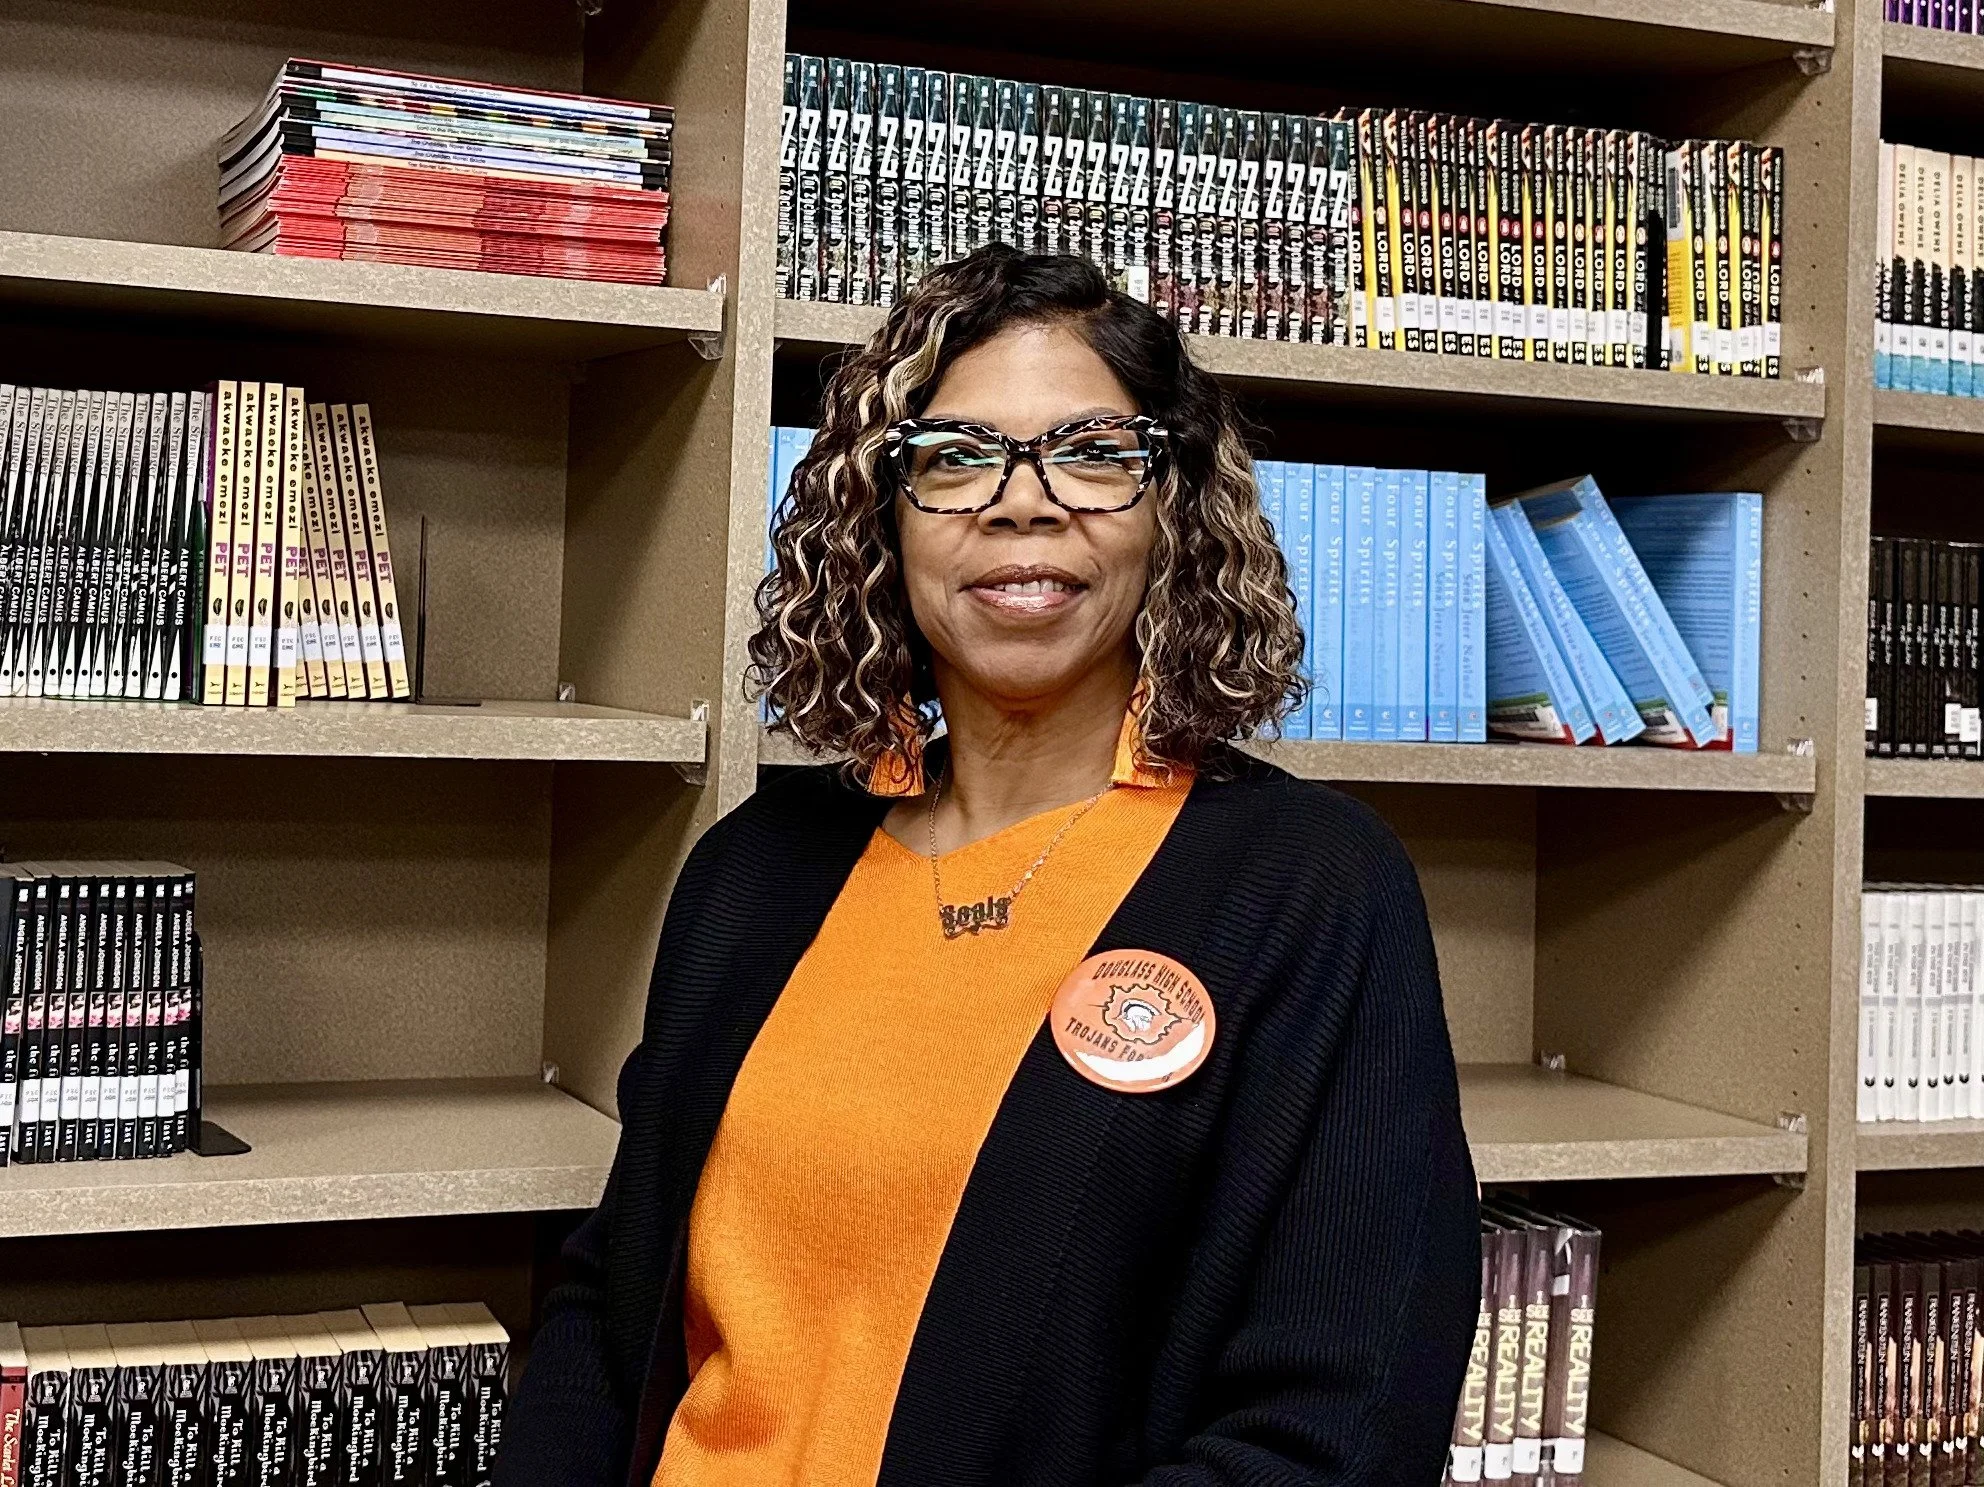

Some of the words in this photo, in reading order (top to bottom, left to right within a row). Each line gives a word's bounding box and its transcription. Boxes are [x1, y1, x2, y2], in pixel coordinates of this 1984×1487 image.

[801, 108, 821, 171] Z
[828, 109, 848, 171] Z
[880, 116, 899, 179] Z
[1403, 233, 1415, 276] LORD
[1421, 235, 1432, 278] LORD
[1442, 237, 1453, 280] LORD
[1459, 239, 1470, 282] LORD
[1478, 241, 1488, 284] LORD
[1534, 245, 1545, 288] LORD
[1556, 245, 1566, 288] LORD
[32, 396, 43, 417] The
[61, 398, 73, 419] The
[91, 400, 102, 421] The
[154, 401, 164, 422] The
[173, 402, 184, 423] The
[222, 391, 232, 467] akwaeke
[244, 393, 255, 468] akwaeke
[267, 393, 279, 467] akwaeke
[290, 398, 300, 472] akwaeke
[26, 422, 40, 475] Stranger
[55, 424, 70, 477] Stranger
[86, 425, 100, 477] Stranger
[150, 427, 163, 479] Stranger
[169, 427, 182, 478] Stranger
[316, 412, 331, 481] akwaeke
[333, 549, 347, 581] PET
[337, 414, 353, 482] akwaeke
[355, 550, 369, 581] PET
[359, 416, 375, 484] akwaeke
[377, 551, 392, 583] PET
[1331, 481, 1343, 525] Four
[1361, 482, 1373, 525] Four
[1387, 484, 1399, 528] Four
[1415, 485, 1426, 528] Four
[13, 545, 25, 583] ALBERT
[43, 546, 55, 584] ALBERT
[75, 546, 86, 584] ALBERT
[140, 548, 150, 586] ALBERT
[159, 549, 170, 587] ALBERT
[214, 542, 227, 577] PET
[236, 543, 250, 578] PET
[260, 542, 273, 577] PET
[285, 547, 298, 580] PET
[314, 548, 329, 579] PET
[1328, 536, 1342, 604] Spirits
[1358, 536, 1373, 604] Spirits
[1384, 539, 1399, 607] Spirits
[1411, 539, 1425, 607] Spirits
[9, 586, 20, 622] CAMUS
[39, 587, 50, 622] CAMUS
[71, 587, 82, 622] CAMUS
[136, 589, 147, 624] CAMUS
[156, 590, 167, 626] CAMUS
[1092, 960, 1156, 980] DOUGLASS
[1154, 965, 1181, 993] HIGH
[91, 1043, 101, 1061] the
[128, 1043, 138, 1061] the
[148, 1042, 158, 1060] the
[1065, 1017, 1118, 1052] TROJANS
[29, 1045, 40, 1064] the
[25, 1126, 36, 1147] last
[85, 1123, 96, 1144] last
[124, 1122, 134, 1143] last
[144, 1122, 154, 1142] last
[1463, 1329, 1490, 1439] REALITY
[1494, 1326, 1520, 1436] REALITY
[1521, 1321, 1548, 1431] REALITY
[1566, 1325, 1593, 1435] REALITY
[5, 1408, 20, 1433] The
[322, 1413, 333, 1430] To
[365, 1409, 375, 1426] To
[410, 1408, 420, 1424] To
[451, 1403, 461, 1420] To
[491, 1399, 502, 1416] To
[304, 1400, 321, 1486] Mockingbird
[321, 1433, 332, 1459] Kill
[346, 1396, 363, 1482] Mockingbird
[363, 1429, 374, 1455] Kill
[391, 1396, 408, 1481] Mockingbird
[408, 1428, 419, 1453] Kill
[433, 1391, 450, 1476] Mockingbird
[450, 1424, 460, 1449] Kill
[474, 1387, 491, 1472] Mockingbird
[490, 1419, 501, 1445] Kill
[320, 1463, 326, 1471] a
[362, 1459, 369, 1467] a
[407, 1457, 413, 1465] a
[449, 1452, 455, 1460] a
[489, 1448, 496, 1456] a
